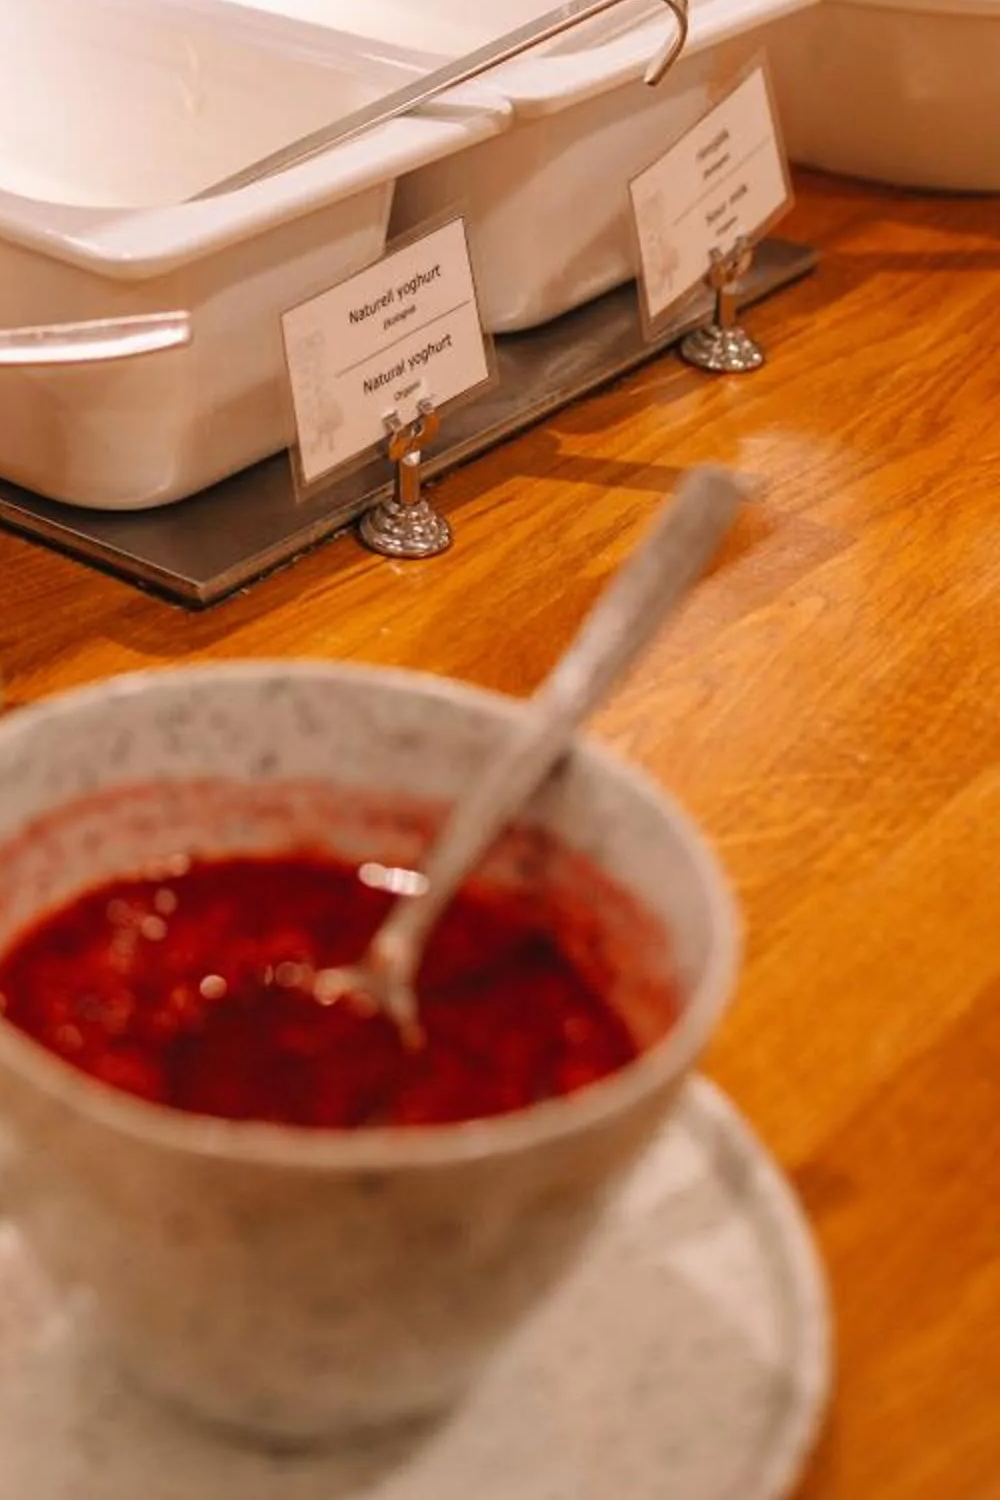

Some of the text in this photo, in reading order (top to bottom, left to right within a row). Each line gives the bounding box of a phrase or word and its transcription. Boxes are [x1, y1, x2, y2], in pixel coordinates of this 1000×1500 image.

[349, 288, 394, 324] Naturell
[397, 264, 441, 300] yoghurt
[363, 358, 405, 394] Natural
[407, 334, 451, 370] yoghurt
